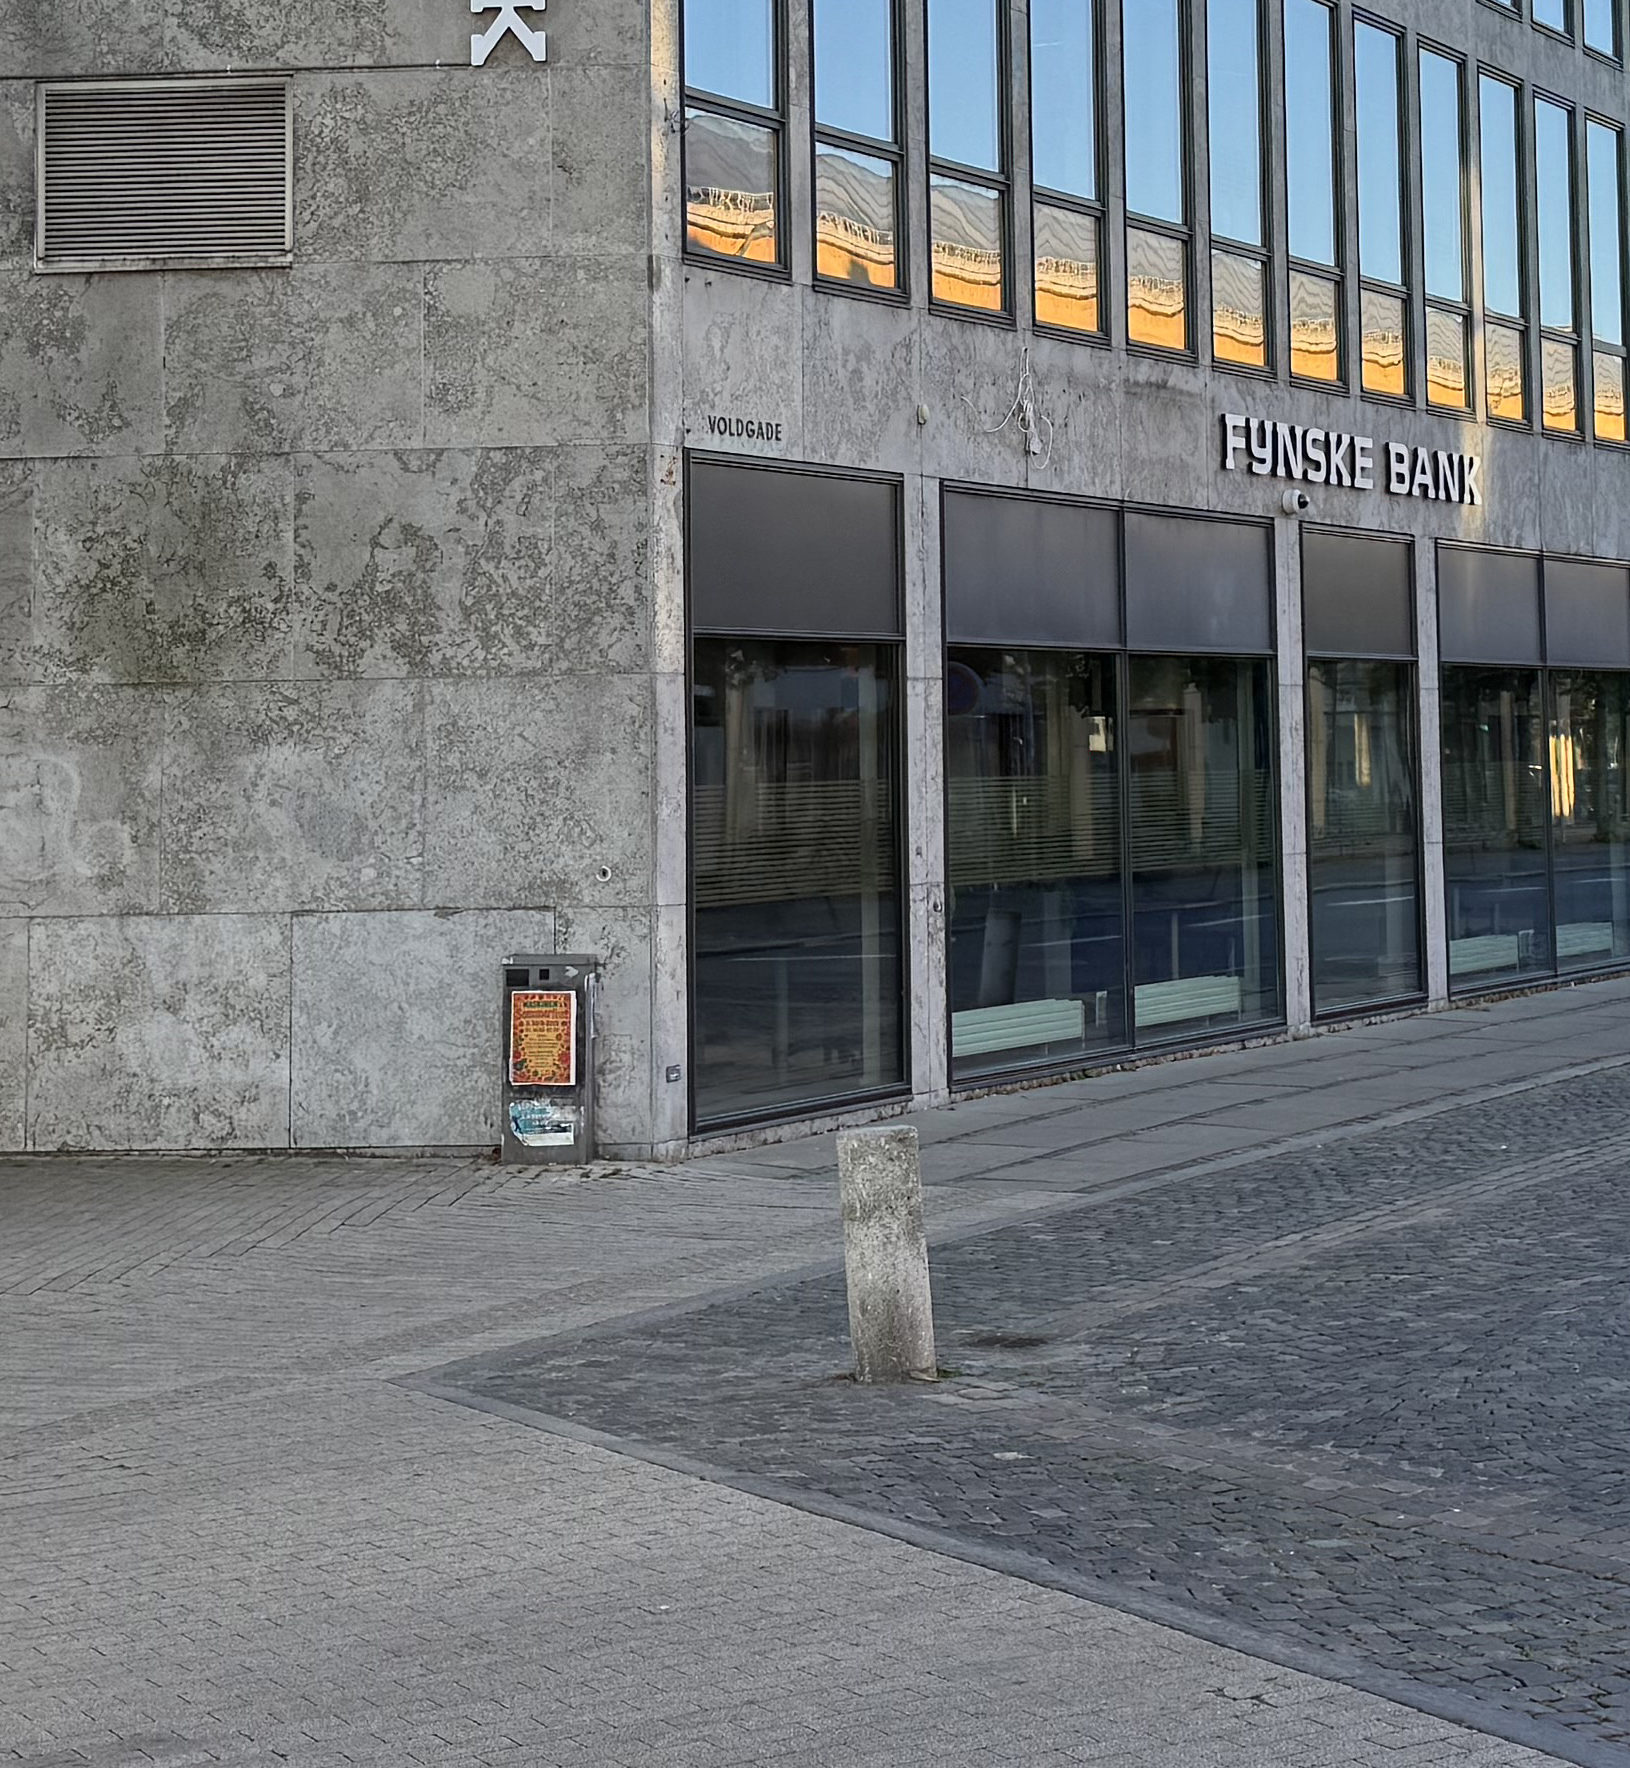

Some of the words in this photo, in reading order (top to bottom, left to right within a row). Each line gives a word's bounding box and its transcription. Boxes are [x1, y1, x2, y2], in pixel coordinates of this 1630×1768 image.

[707, 414, 782, 442] VOLDGADE
[1223, 412, 1374, 490] FYNSKE
[1385, 441, 1483, 506] BANK
